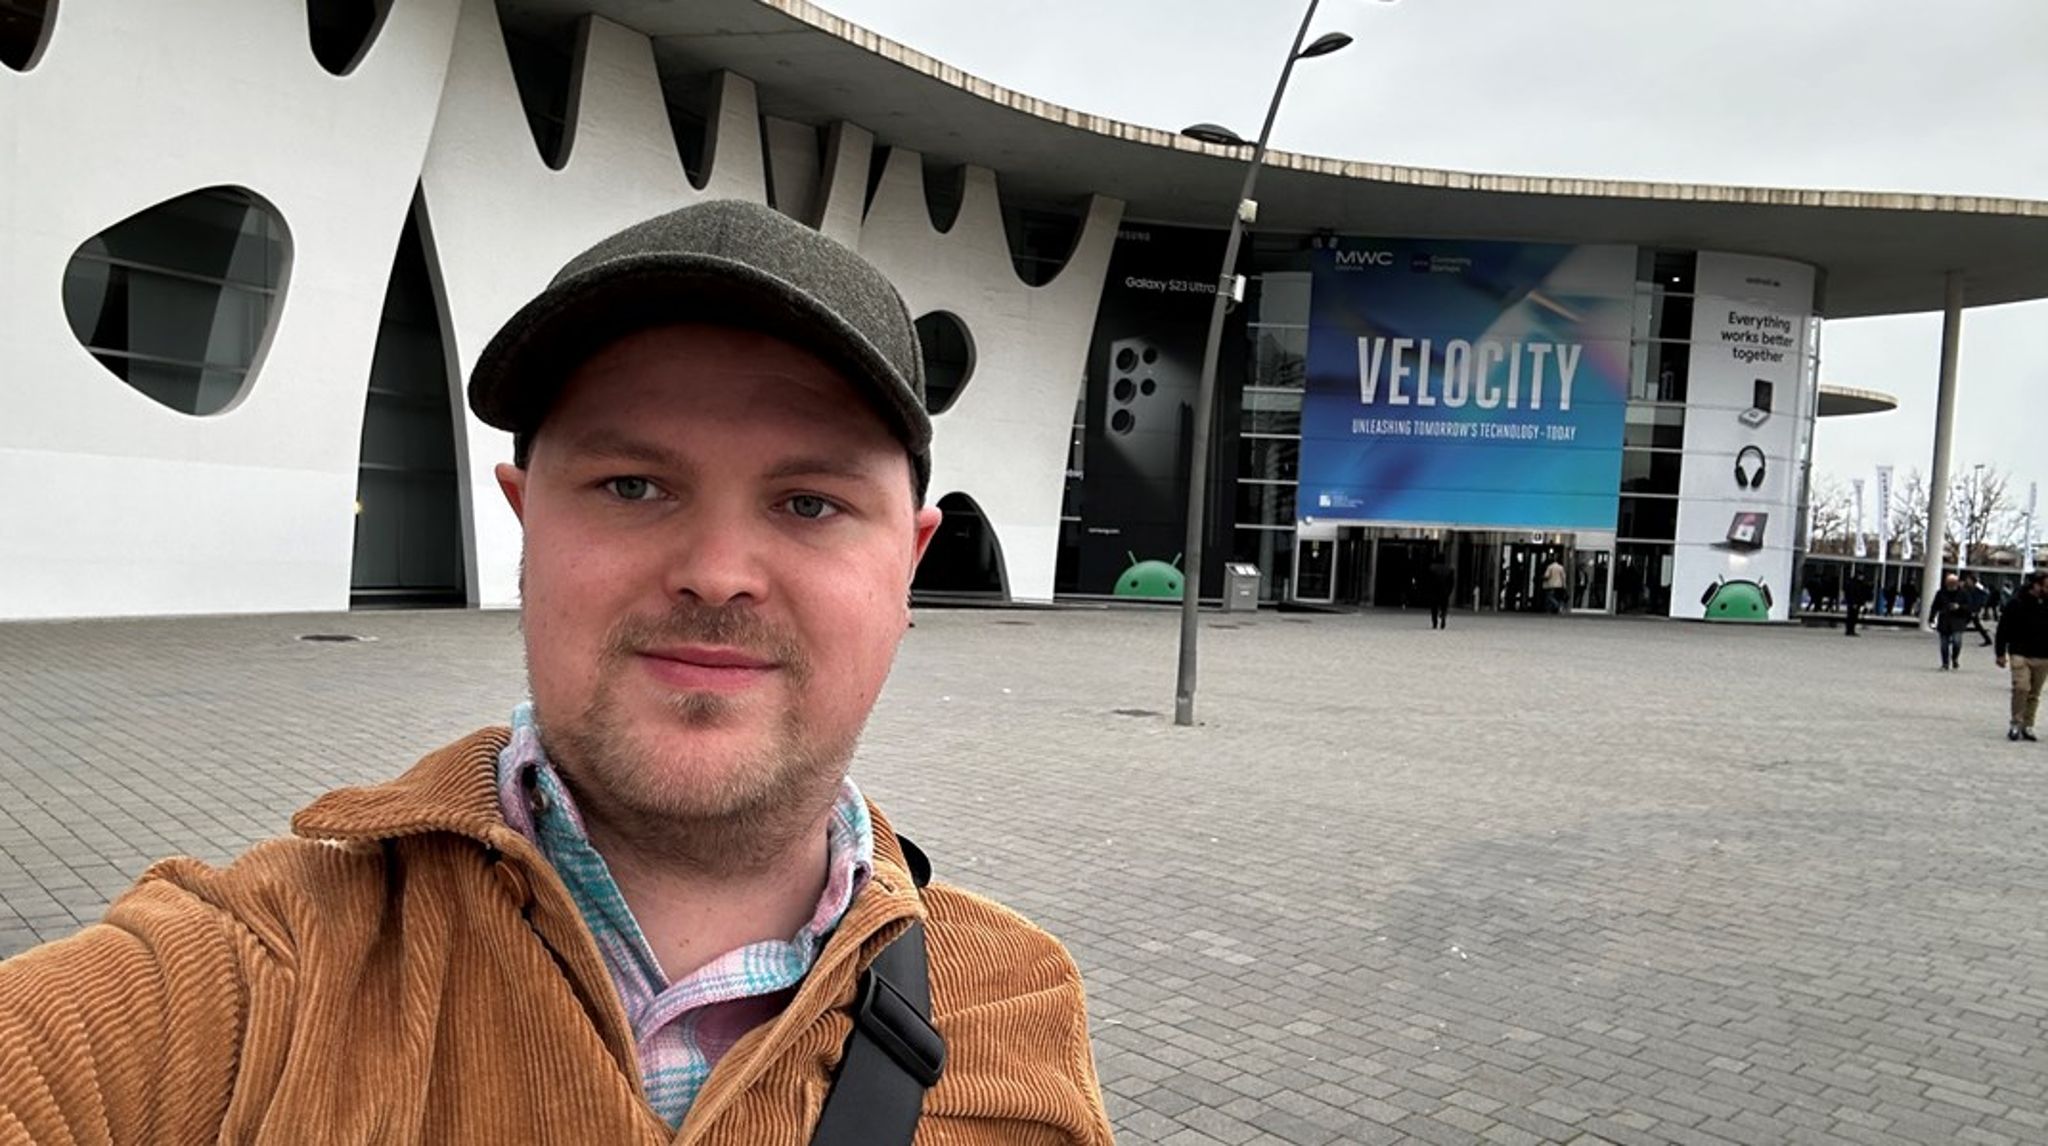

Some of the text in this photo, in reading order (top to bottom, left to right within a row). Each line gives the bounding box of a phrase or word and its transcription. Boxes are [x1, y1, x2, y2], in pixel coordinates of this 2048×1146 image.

[1335, 250, 1394, 266] MWC
[1125, 276, 1217, 294] Galaxy S23 Ultra
[1727, 311, 1791, 335] Everything
[1721, 330, 1794, 348] works better
[1733, 346, 1784, 364] together
[1357, 335, 1584, 412] VELOCITY
[1352, 418, 1412, 436] UNLEASHING
[1413, 419, 1479, 438] TOMORROW'S
[1480, 421, 1540, 440] TECHNOLOGY
[1545, 424, 1577, 441] TODAY
